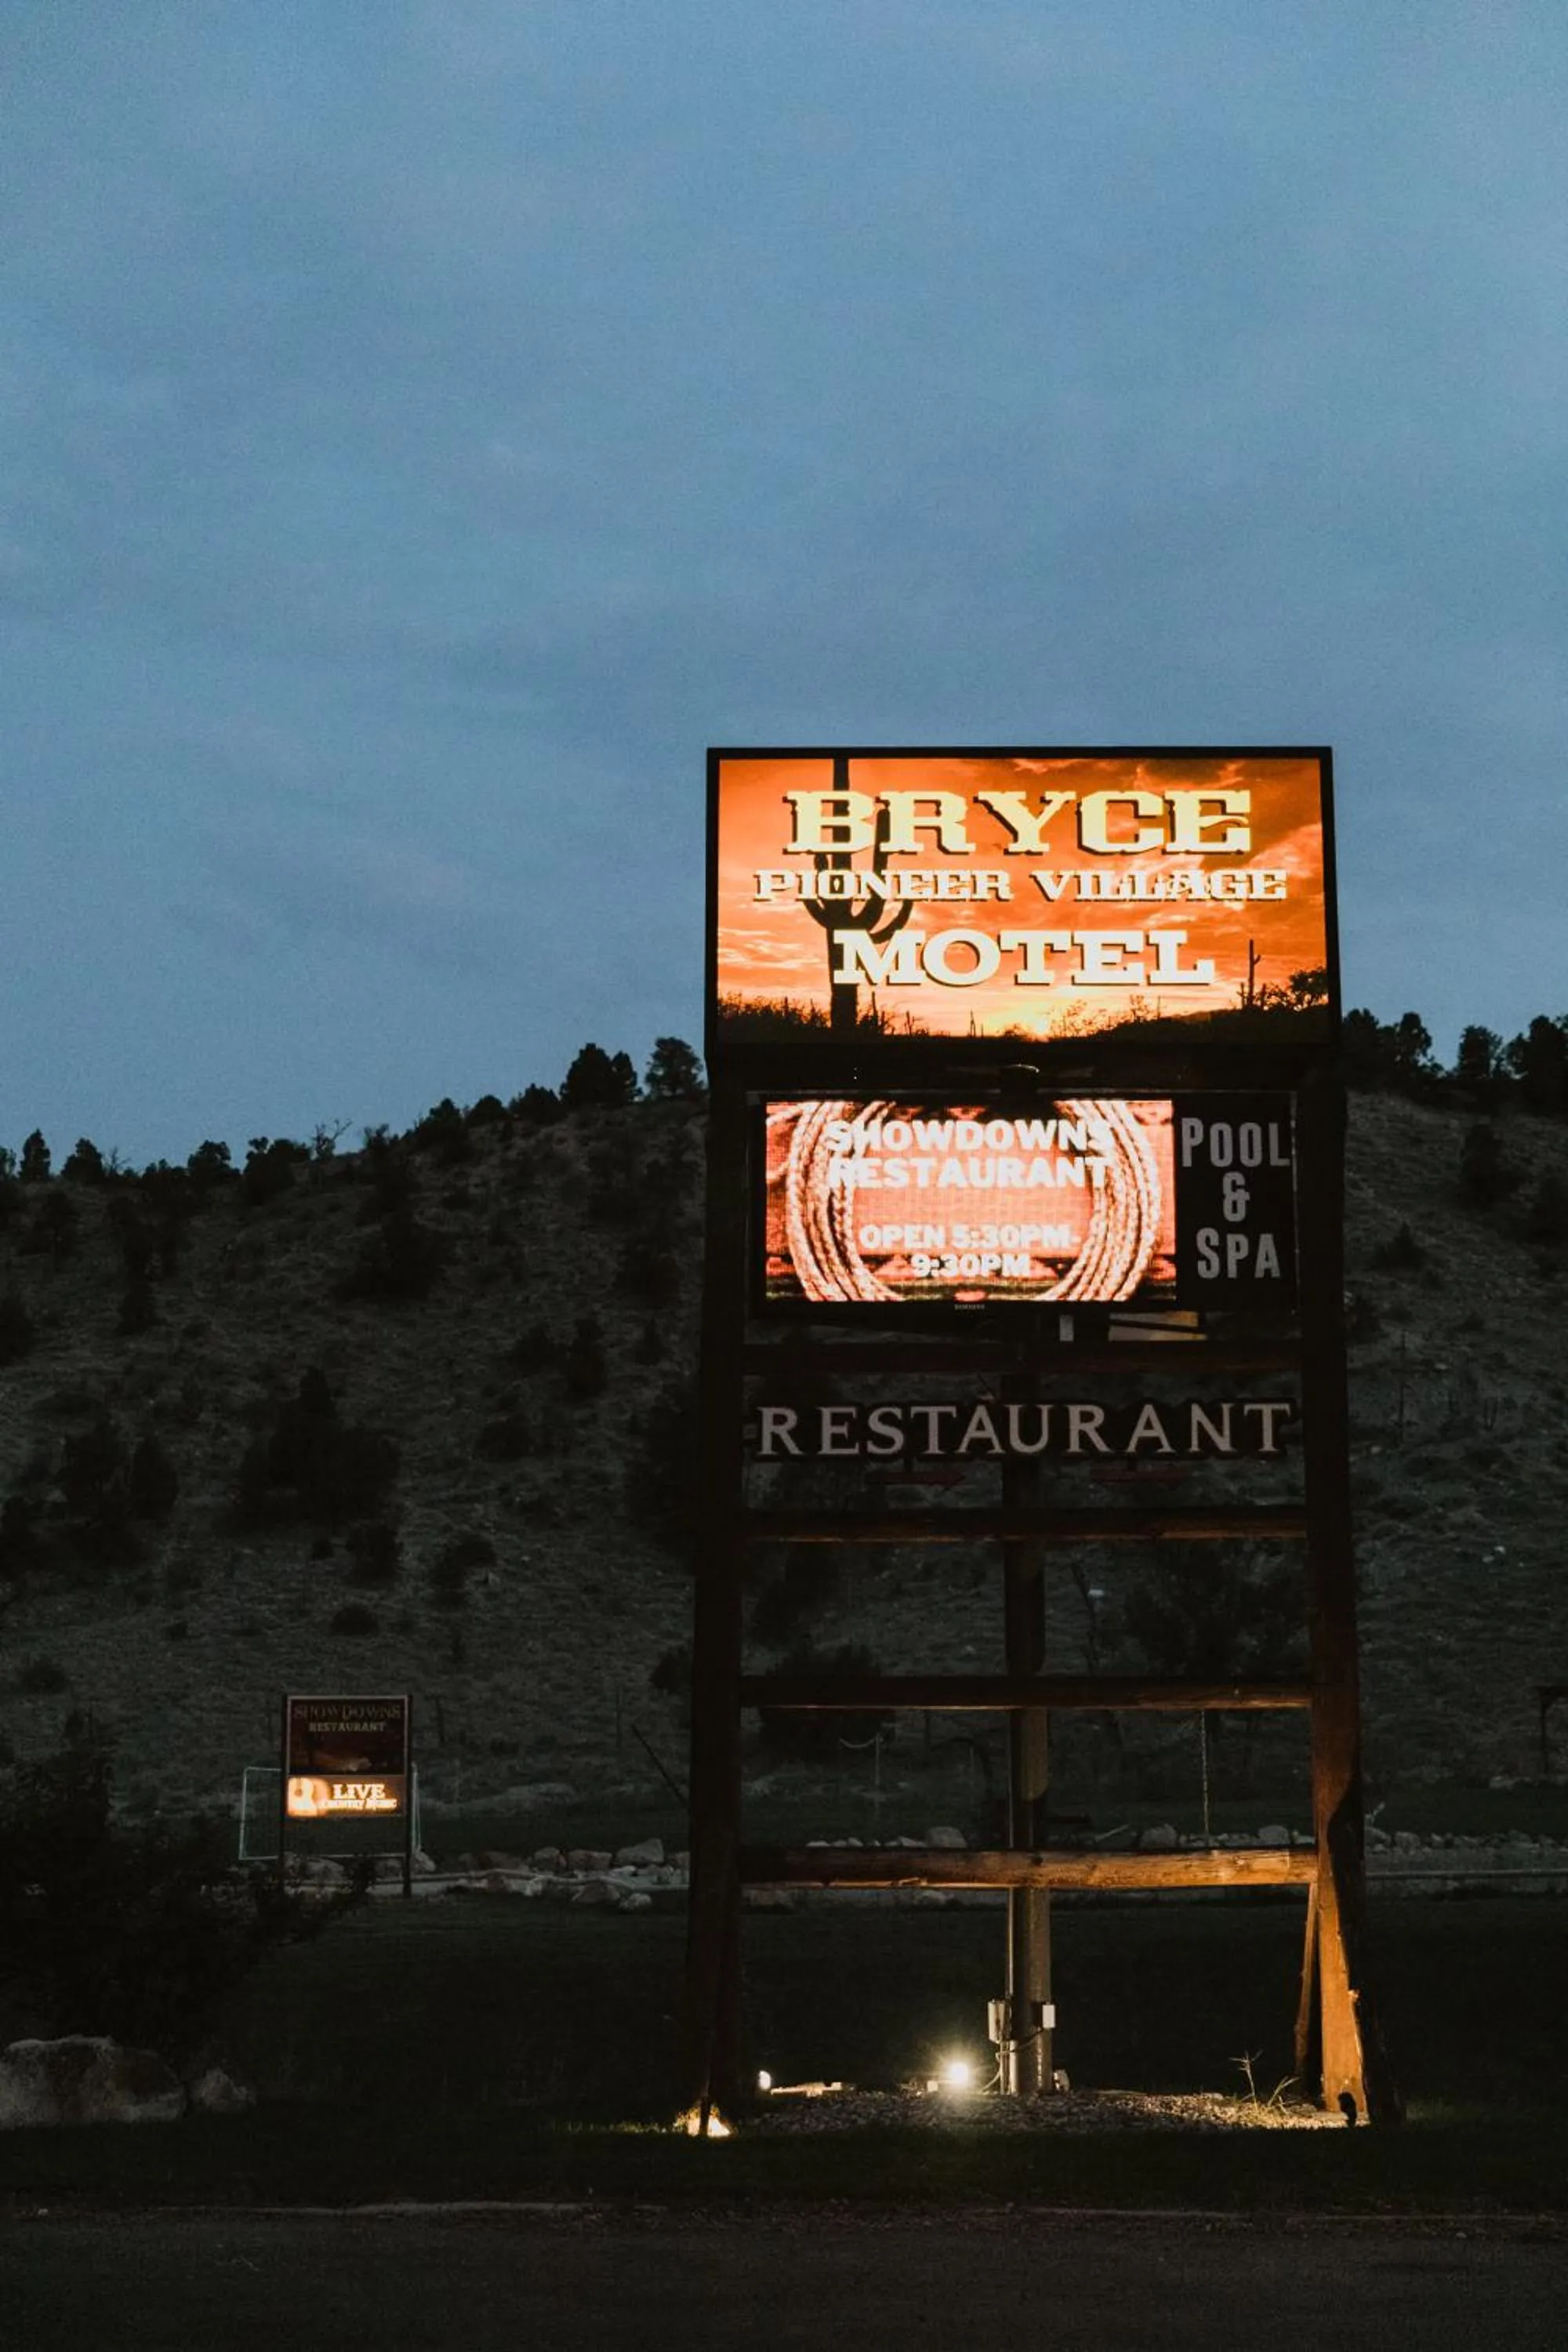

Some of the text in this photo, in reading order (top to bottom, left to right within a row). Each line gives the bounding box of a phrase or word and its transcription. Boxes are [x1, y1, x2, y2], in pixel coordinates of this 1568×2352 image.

[784, 790, 1250, 855] BRYCE
[754, 868, 1287, 902] PIONEER VILLAGE
[833, 929, 1214, 985] MOTEL
[825, 1119, 1116, 1152] SHOWDOWNS
[1181, 1117, 1290, 1167] POOL
[828, 1157, 1109, 1189] RESTAURANT
[1222, 1171, 1250, 1222] &
[859, 1225, 946, 1248] OPEN
[1196, 1228, 1281, 1279] SPA
[911, 1254, 1031, 1277] 9:30PM
[757, 1403, 1292, 1456] RESTAURANT
[308, 1722, 385, 1732] RESTAURANT
[332, 1784, 385, 1798] LIVE
